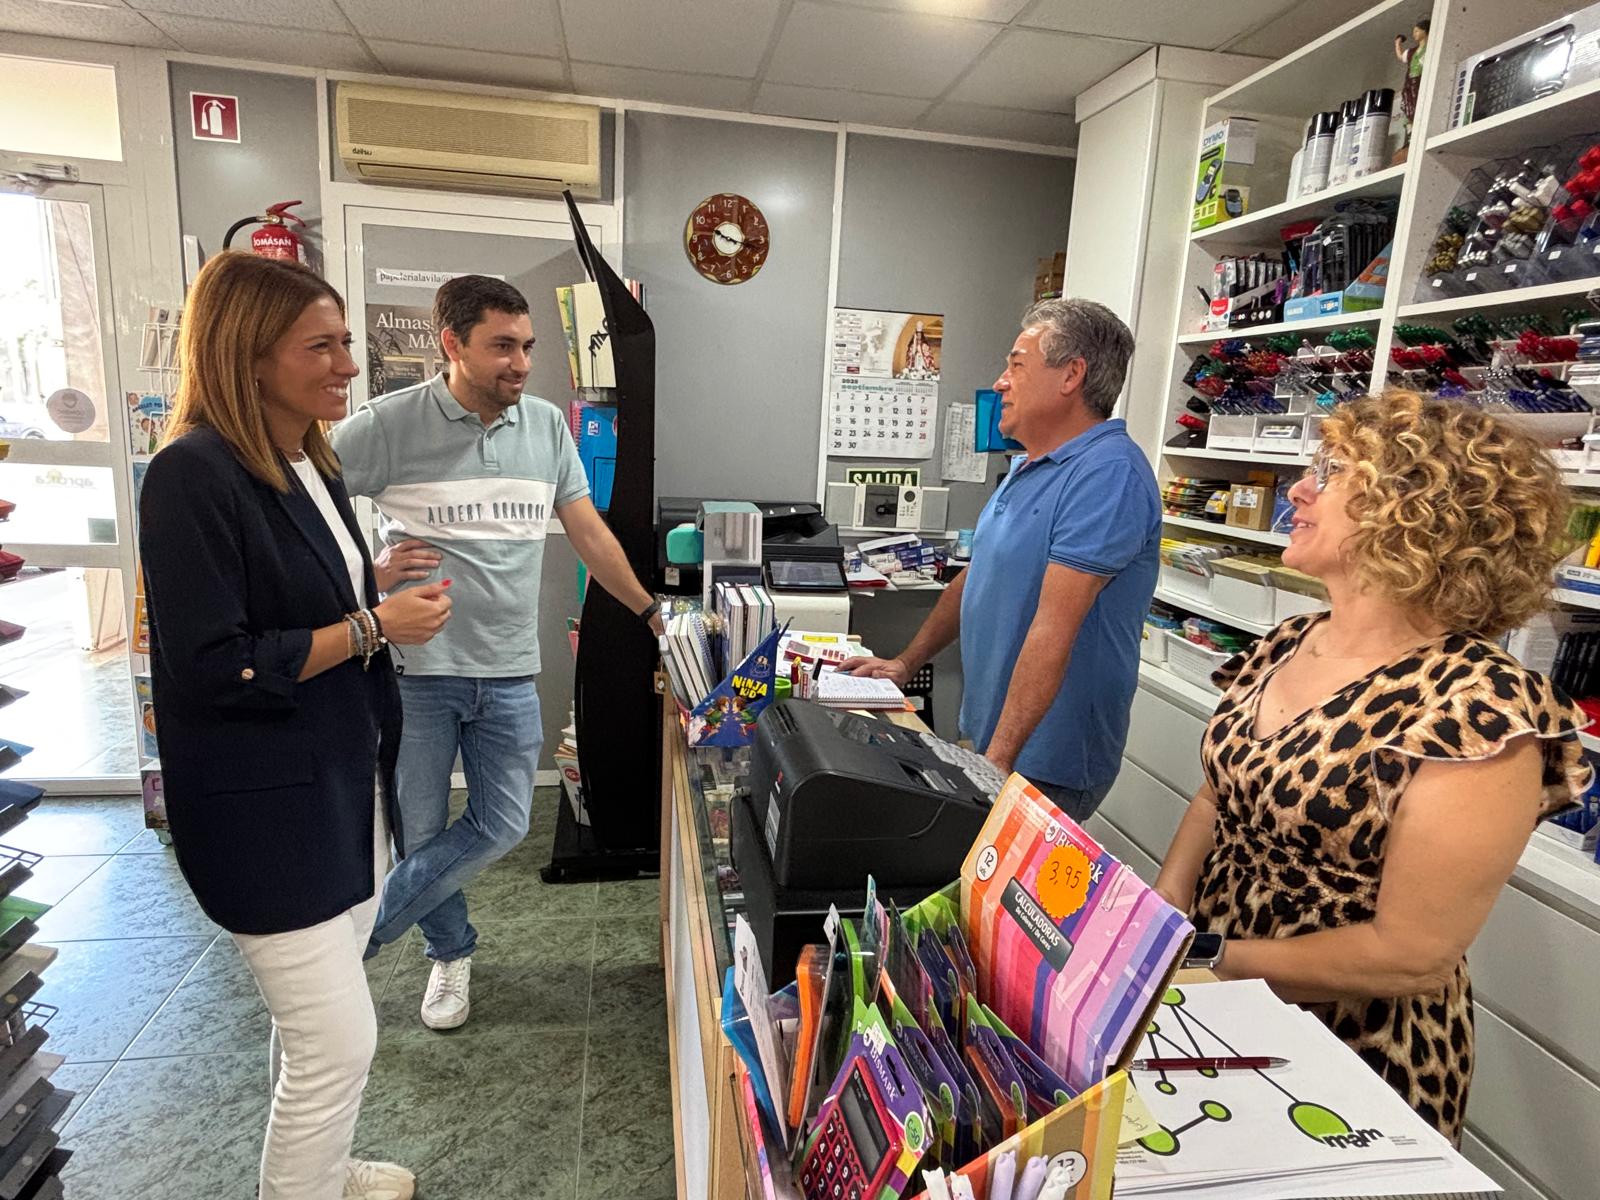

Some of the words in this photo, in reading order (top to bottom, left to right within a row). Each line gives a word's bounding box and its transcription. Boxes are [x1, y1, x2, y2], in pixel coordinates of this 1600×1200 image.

[1203, 131, 1224, 146] DYMO
[708, 204, 715, 213] 11
[696, 215, 705, 224] 10
[693, 235, 697, 243] 9
[760, 236, 765, 244] 3
[726, 270, 732, 278] 6
[408, 329, 438, 350] MÀ
[428, 503, 482, 524] ALBERT
[984, 851, 994, 868] 12
[1048, 860, 1082, 889] 3,95
[1015, 891, 1061, 947] CALCULADORAS
[906, 1117, 921, 1146] C-50
[827, 1122, 835, 1135] 7
[834, 1145, 842, 1159] 8
[842, 1166, 850, 1179] 9
[812, 1158, 819, 1170] 1
[818, 1178, 826, 1192] 2
[819, 1142, 827, 1154] 4
[826, 1162, 834, 1175] 5
[833, 1183, 841, 1197] 6
